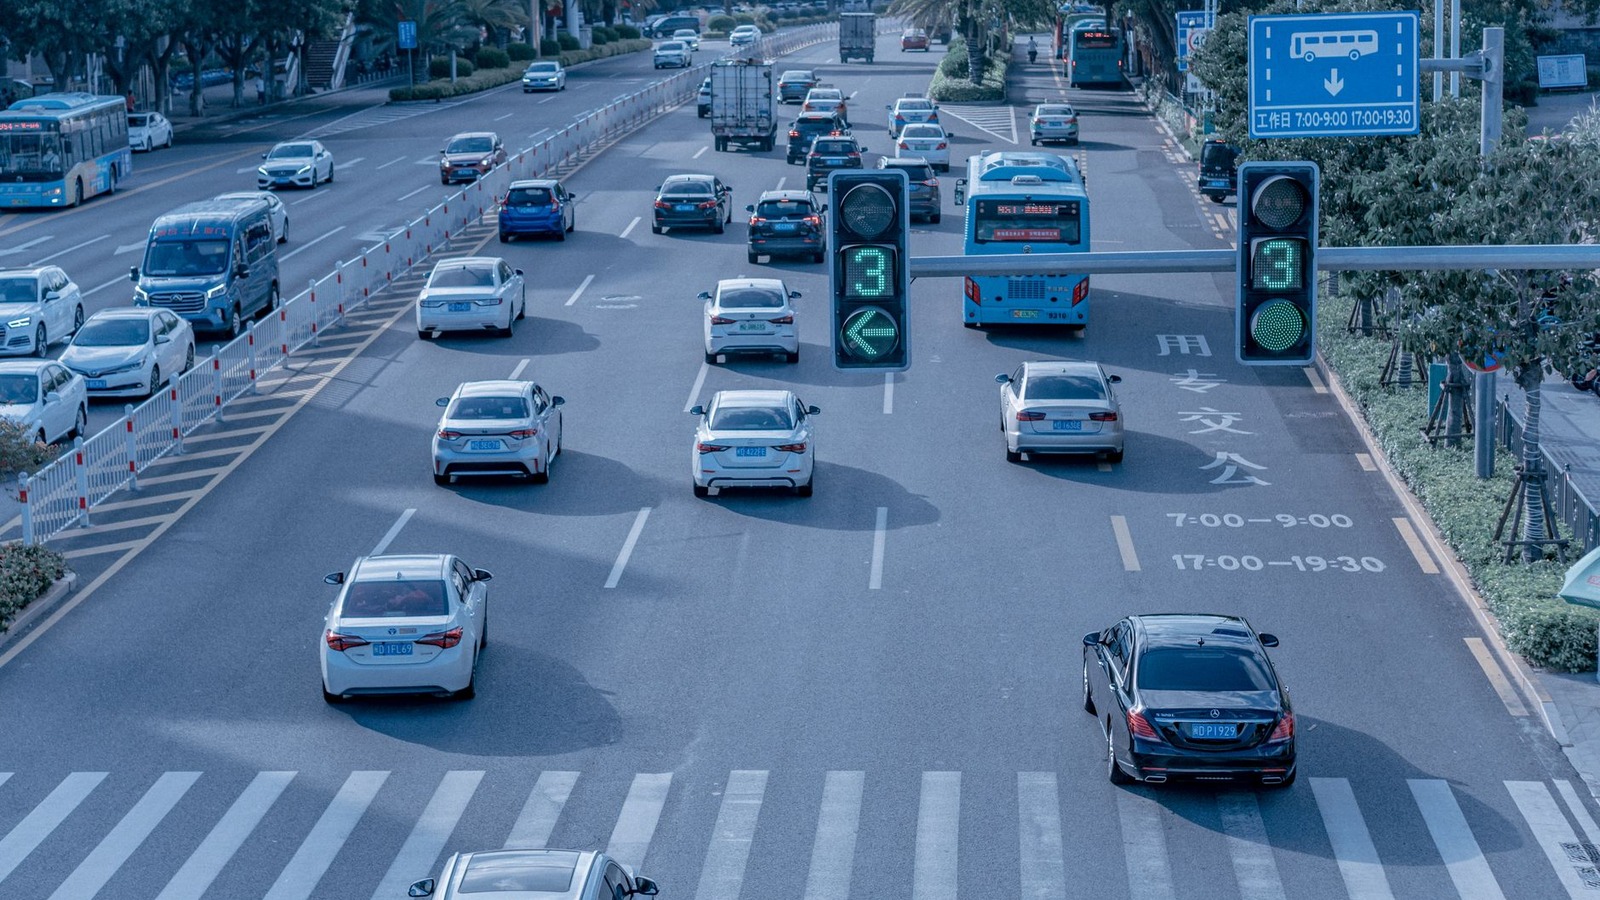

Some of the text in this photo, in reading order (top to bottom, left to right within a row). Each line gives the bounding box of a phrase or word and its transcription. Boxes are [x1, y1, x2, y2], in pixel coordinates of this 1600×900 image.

[1257, 109, 1410, 129] 工作日 7:00-9:00 17:00-19:30
[855, 249, 884, 295] 3
[1263, 242, 1292, 288] 3
